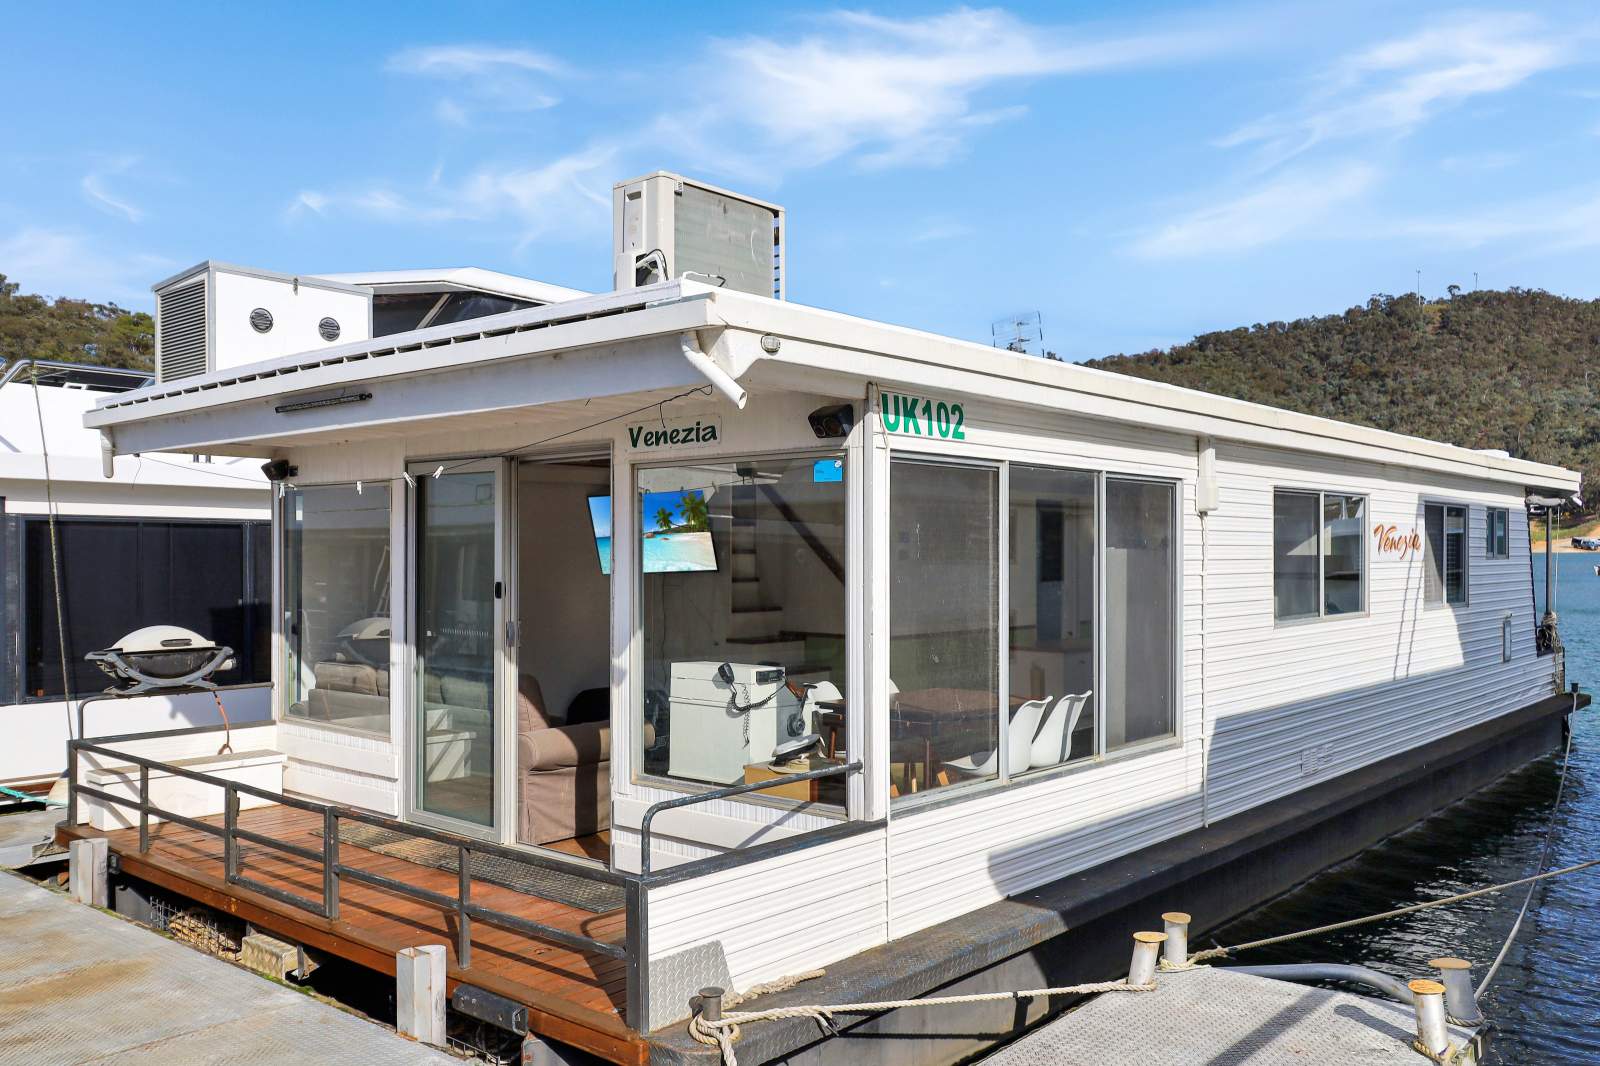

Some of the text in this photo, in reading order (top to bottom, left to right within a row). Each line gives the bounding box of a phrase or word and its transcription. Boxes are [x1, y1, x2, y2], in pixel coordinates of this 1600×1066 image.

[628, 421, 718, 448] Venezia
[881, 393, 965, 440] UK102
[1373, 524, 1421, 560] Venezia
